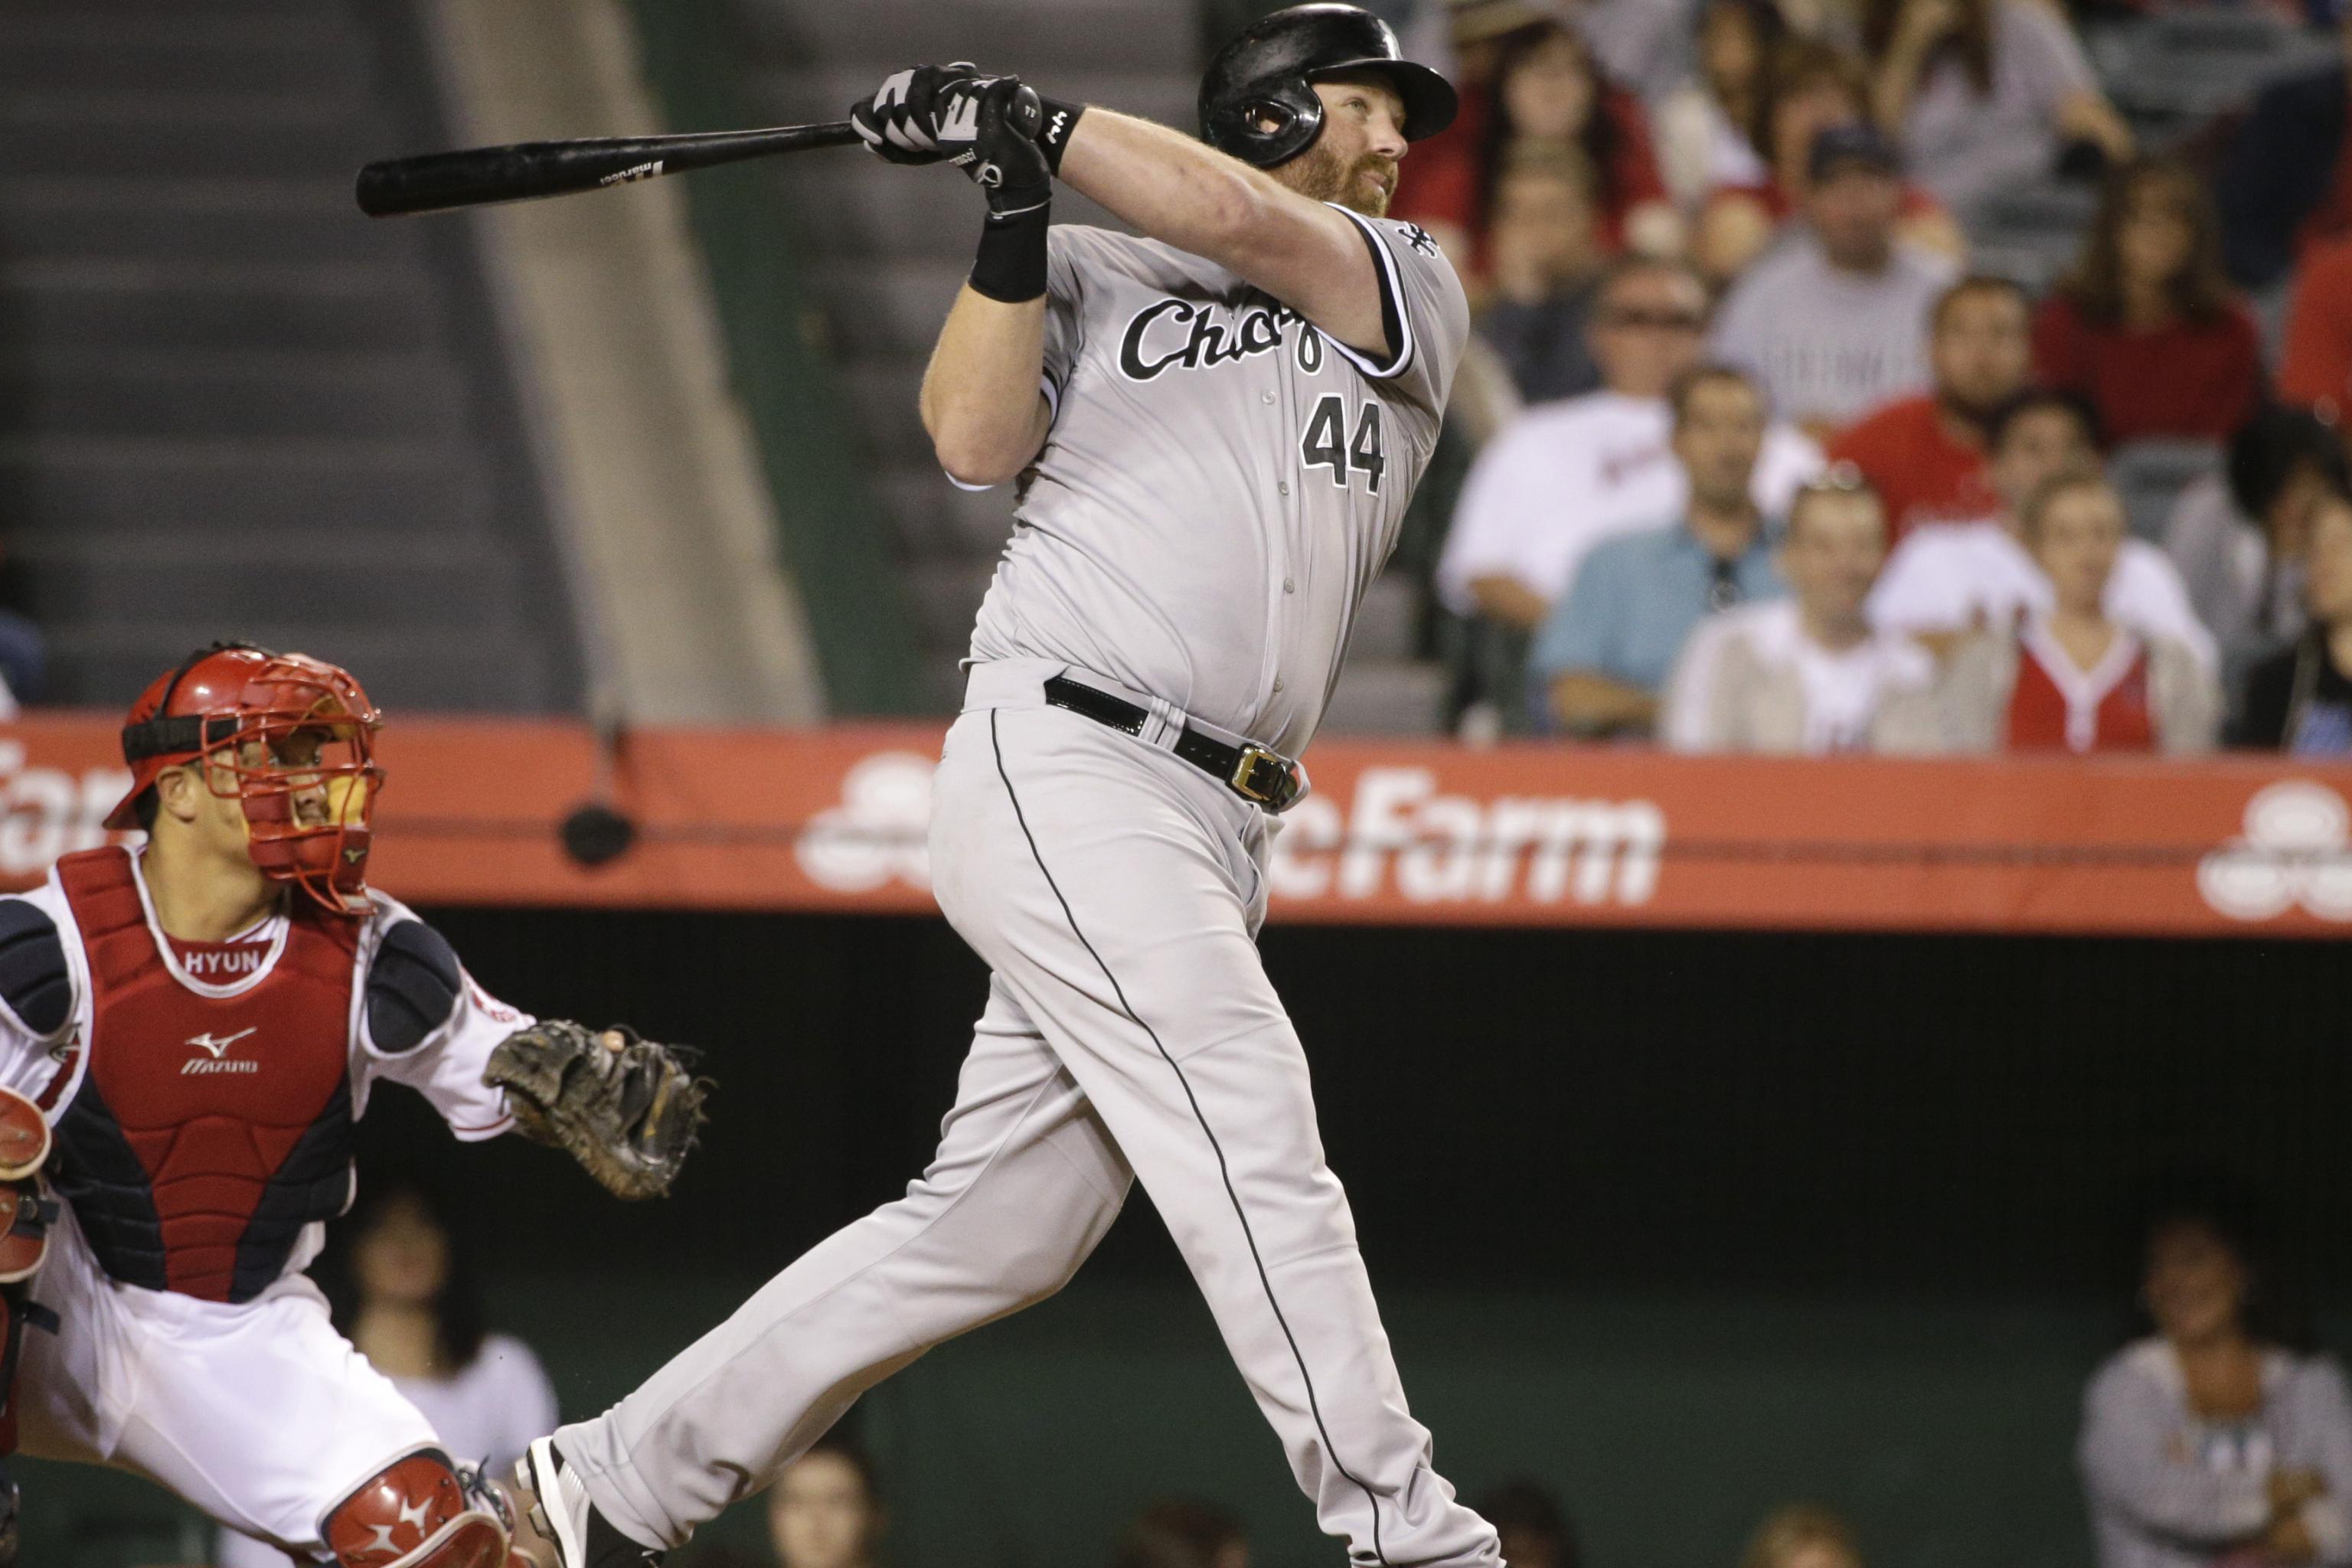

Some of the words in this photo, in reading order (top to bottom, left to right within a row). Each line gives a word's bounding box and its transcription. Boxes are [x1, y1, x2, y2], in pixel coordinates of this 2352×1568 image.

[599, 162, 652, 185] marucci
[1298, 393, 1387, 497] 44
[185, 951, 260, 974] HYUN
